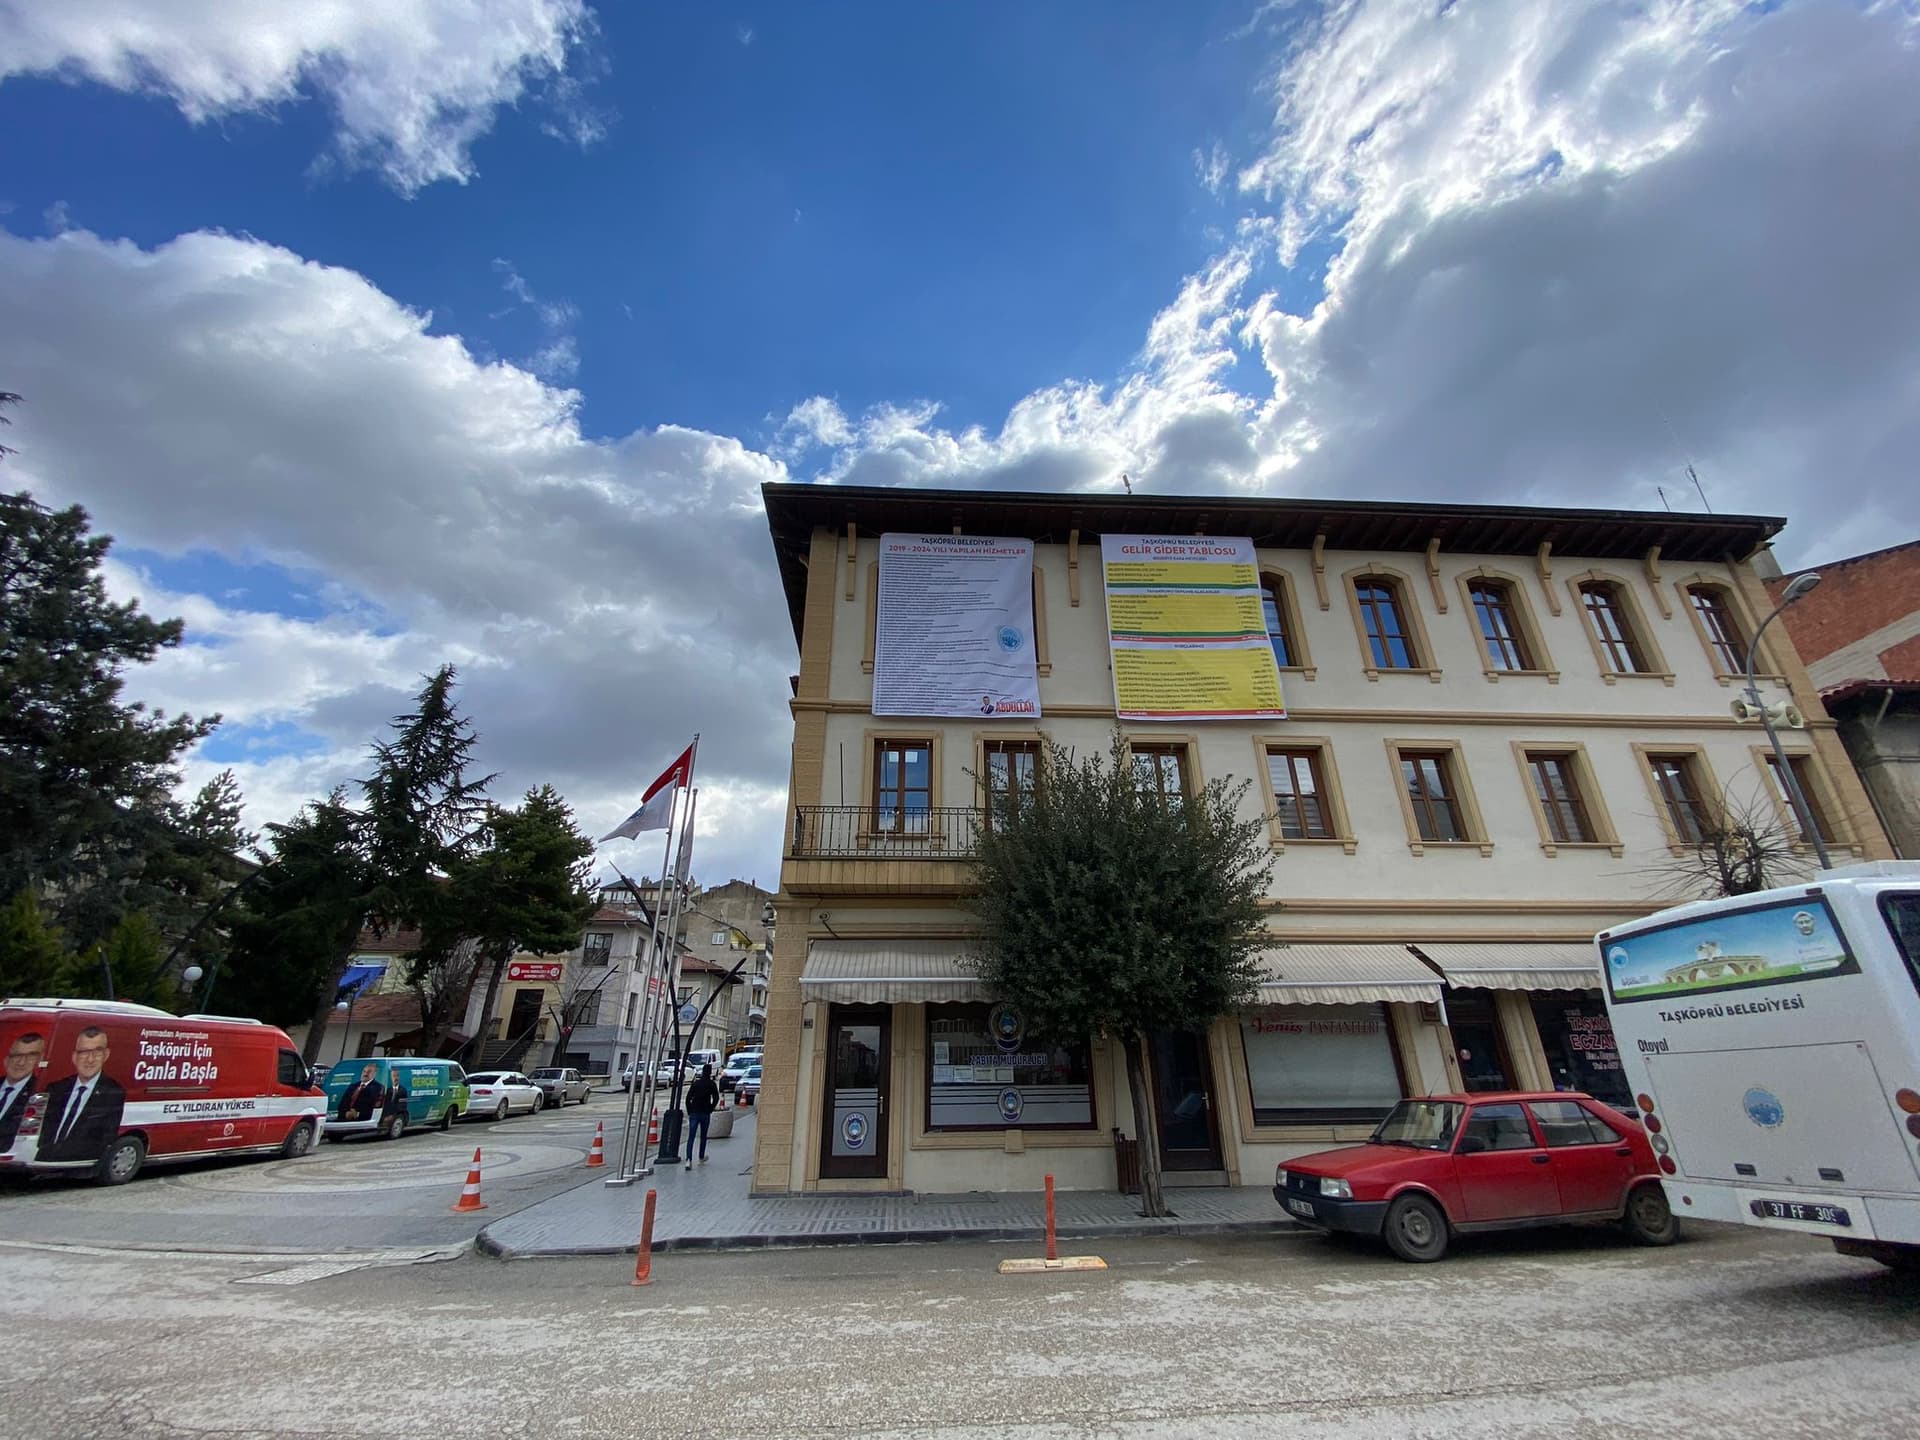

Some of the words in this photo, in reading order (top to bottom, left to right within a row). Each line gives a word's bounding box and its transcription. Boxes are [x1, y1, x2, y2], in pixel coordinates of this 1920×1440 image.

[912, 545, 931, 553] 2024
[949, 546, 982, 554] YAPILAN
[1121, 544, 1152, 554] GELİR
[1154, 544, 1186, 555] GİDER
[1187, 546, 1237, 555] TABLOSU
[1659, 1003, 1724, 1024] TAŞKÖPRÜ
[1726, 994, 1805, 1016] BELEDİYESİ
[1567, 1014, 1613, 1034] TAŞKÖ
[140, 1041, 192, 1060] Taşköprü
[193, 1040, 212, 1060] İçin
[1637, 1038, 1670, 1055] Otoyol
[134, 1060, 177, 1081] Canla
[180, 1061, 218, 1084] Başla
[183, 1102, 224, 1113] YILDIRAN
[225, 1099, 256, 1111] YÜKSEL
[1770, 1202, 1785, 1217] 37
[1790, 1204, 1804, 1219] FF
